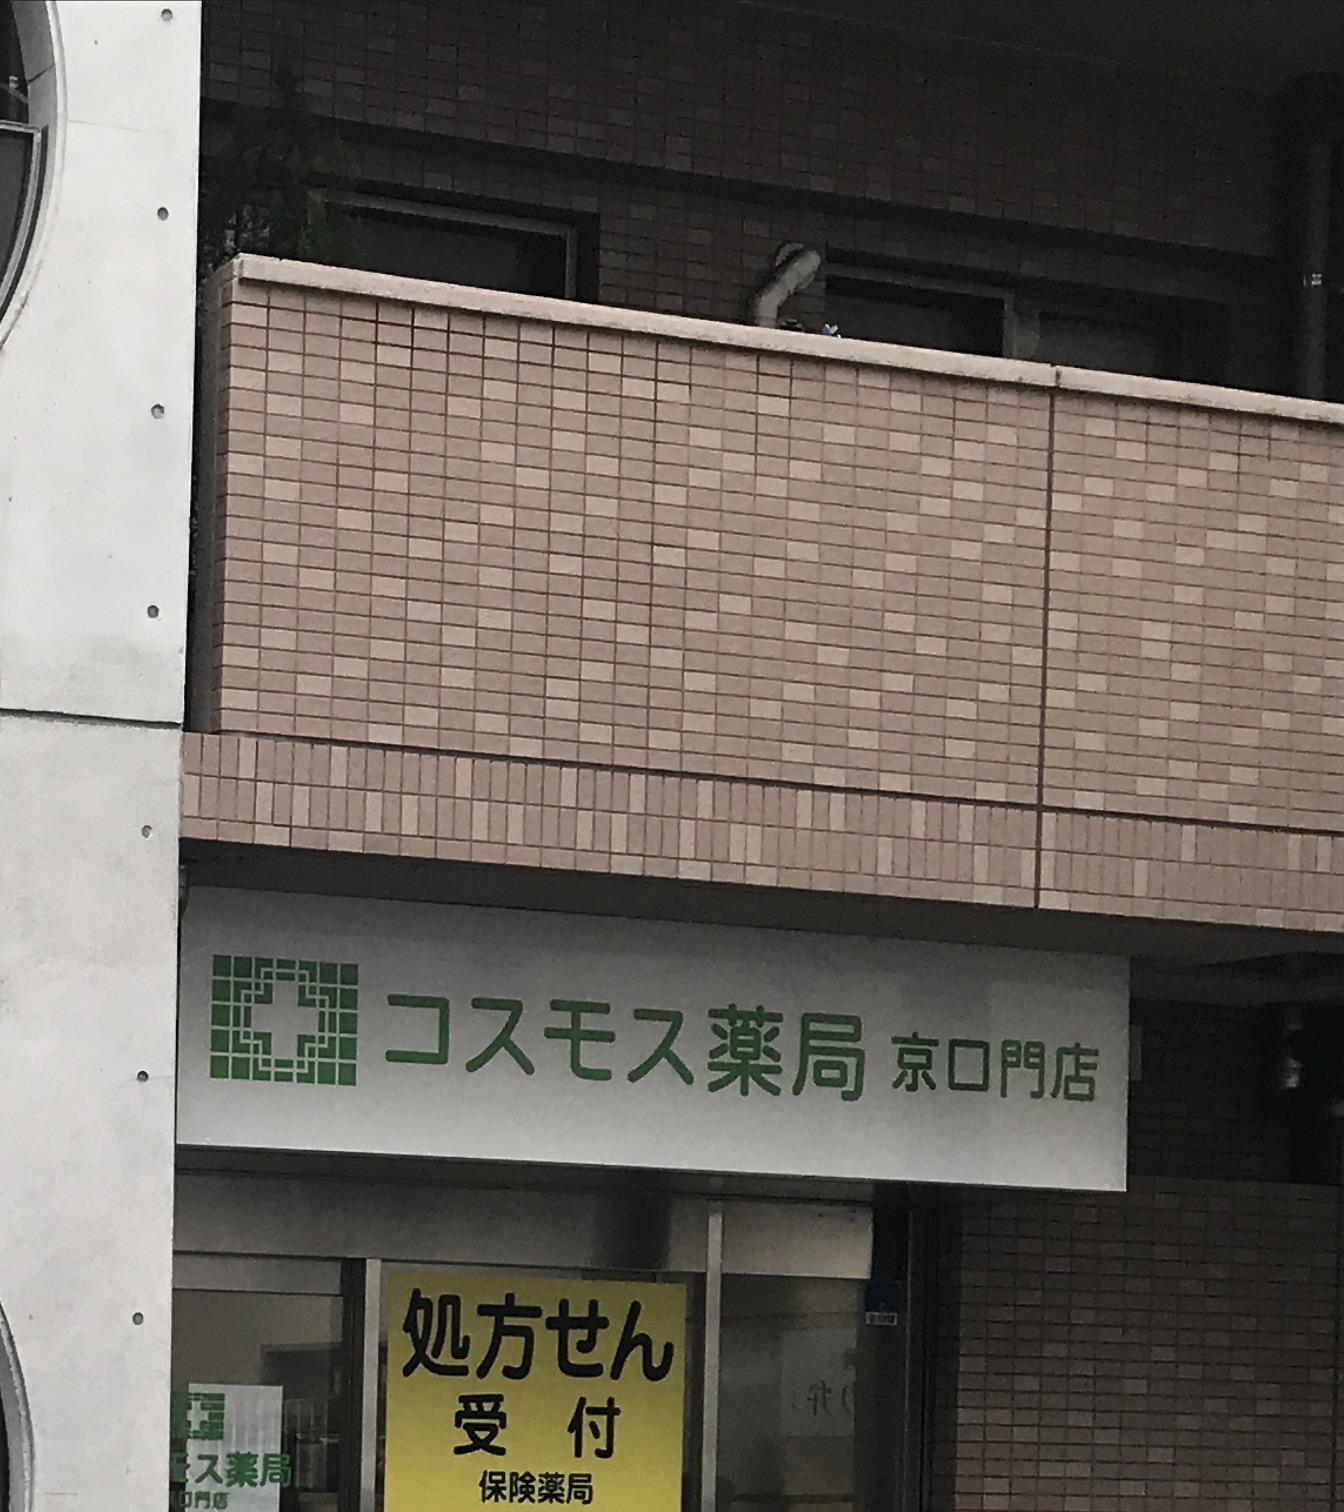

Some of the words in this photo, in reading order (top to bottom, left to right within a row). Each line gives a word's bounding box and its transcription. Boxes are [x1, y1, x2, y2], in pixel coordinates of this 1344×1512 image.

[383, 991, 865, 1101] コスモス薬局
[889, 1030, 1101, 1102] 京口門店
[400, 1288, 675, 1382] 処方せん
[170, 1491, 229, 1510] 口門店
[478, 1470, 595, 1506] 保険薬局
